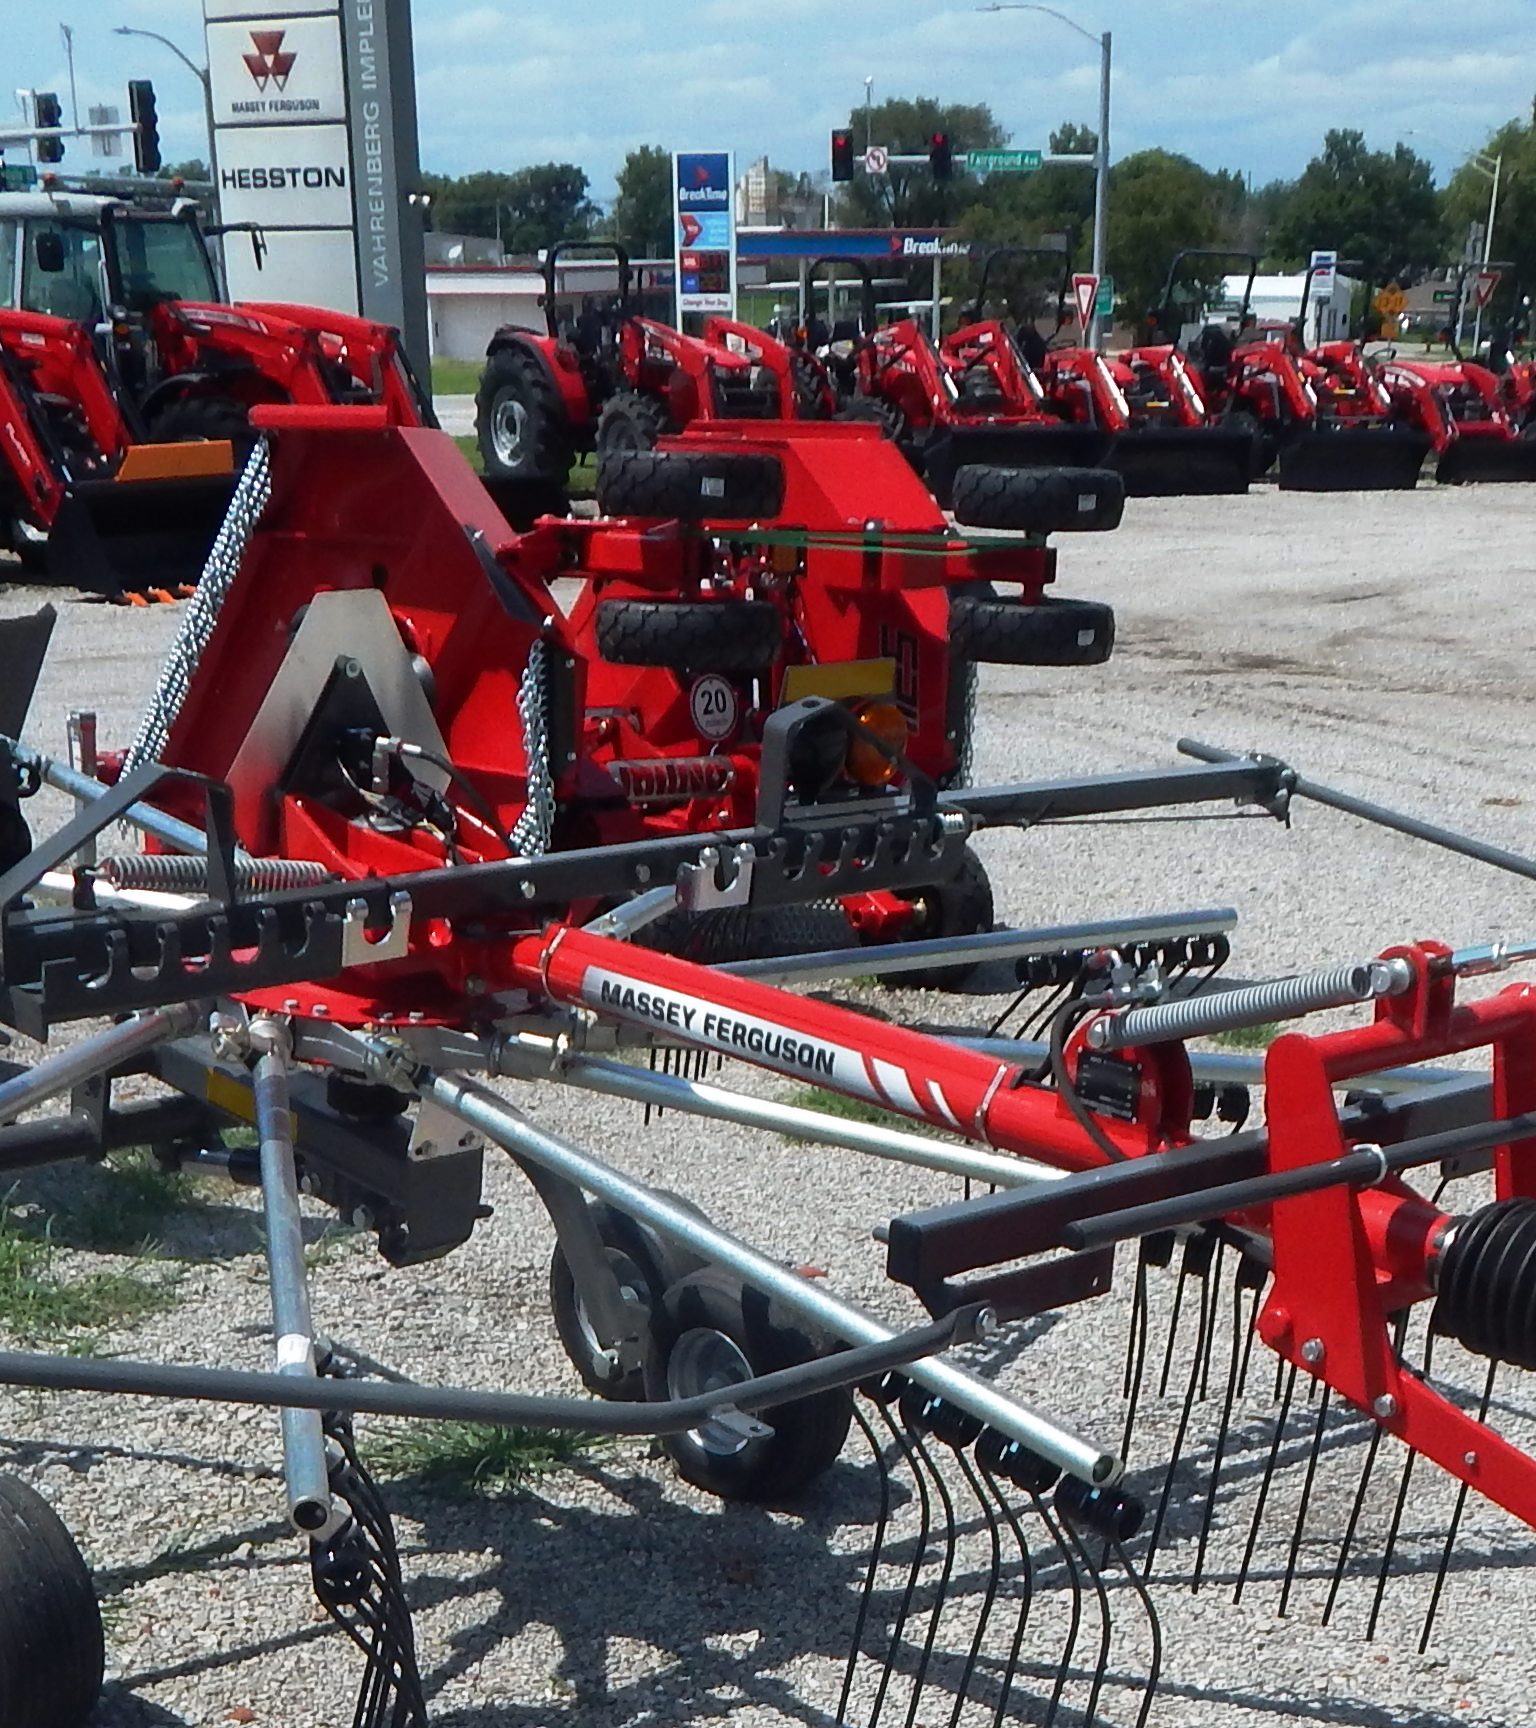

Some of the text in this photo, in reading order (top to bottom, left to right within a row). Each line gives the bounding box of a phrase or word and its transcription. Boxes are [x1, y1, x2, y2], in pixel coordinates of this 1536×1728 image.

[232, 99, 320, 113] MASSEY FERGUSON
[357, 0, 389, 287] VAHRENBERG IMPLE
[221, 166, 345, 189] HESSTON
[700, 689, 727, 715] 20
[600, 979, 836, 1078] MASSEY FERGUSON
